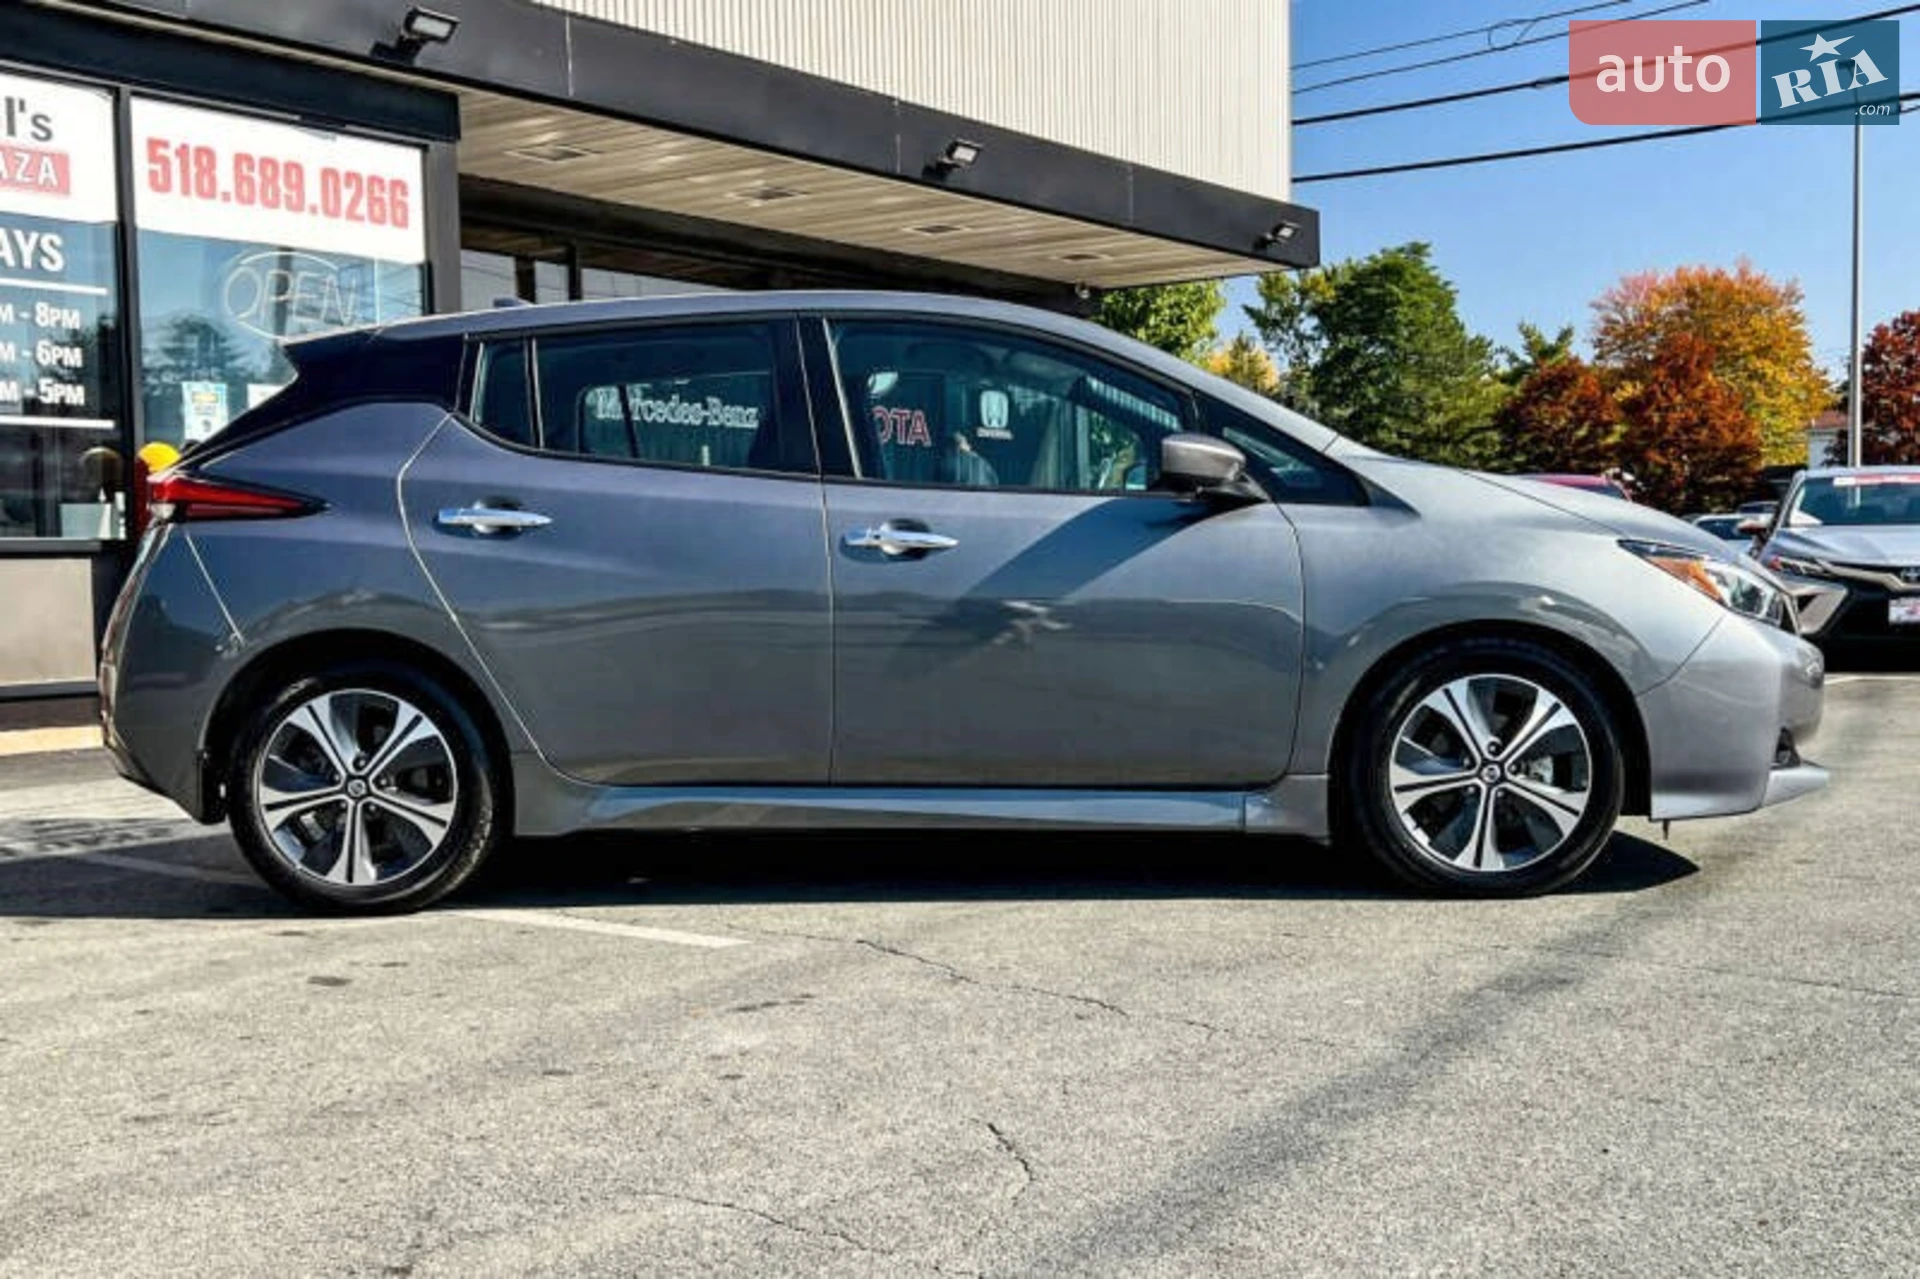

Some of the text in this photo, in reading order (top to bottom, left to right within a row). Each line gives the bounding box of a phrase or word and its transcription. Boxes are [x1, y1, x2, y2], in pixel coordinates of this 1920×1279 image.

[146, 137, 411, 229] 518.689.0266
[224, 265, 357, 327] OPEN
[35, 301, 81, 330] 8PM
[36, 339, 83, 368] 6PM
[38, 378, 85, 406] 5PM
[596, 387, 759, 429] Mrcedes-Benz
